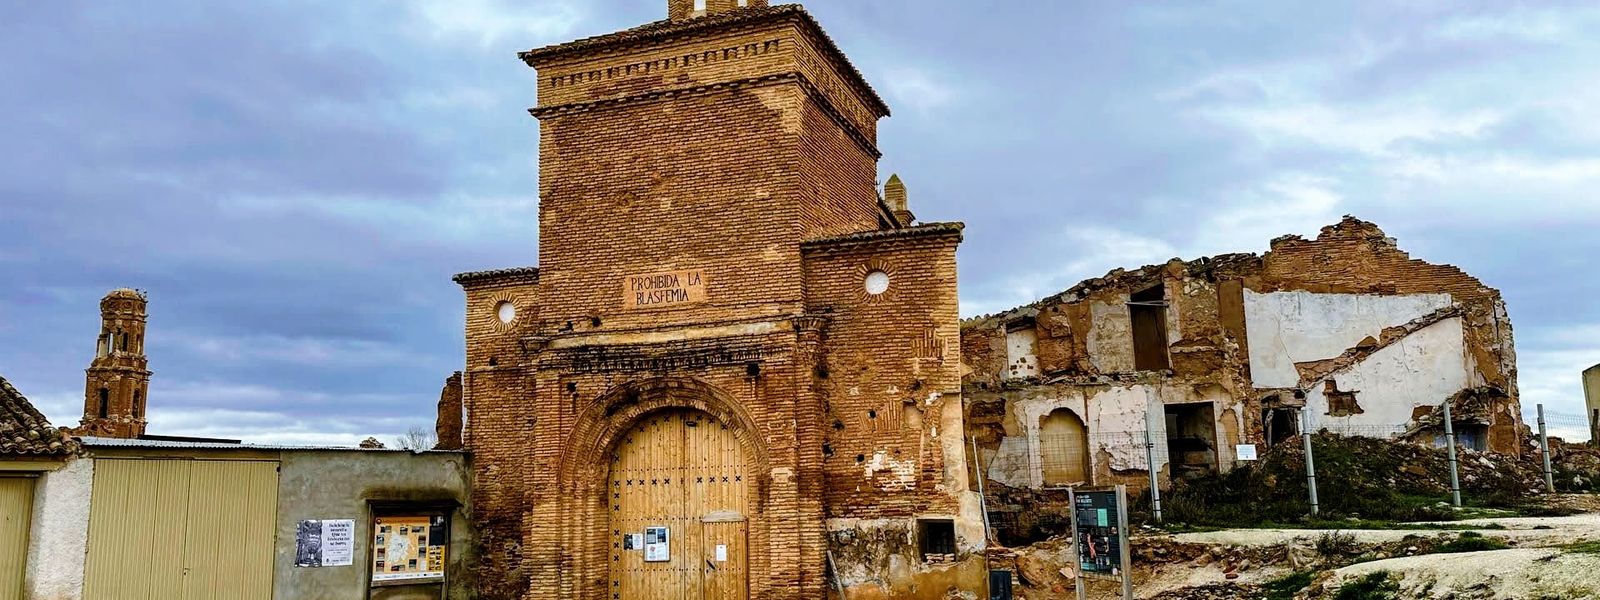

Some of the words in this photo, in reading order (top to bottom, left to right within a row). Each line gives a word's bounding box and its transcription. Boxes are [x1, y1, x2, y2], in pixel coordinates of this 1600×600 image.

[631, 275, 680, 291] PROHIBIDA
[688, 272, 701, 286] LA
[636, 288, 689, 305] BLASFEMIA
